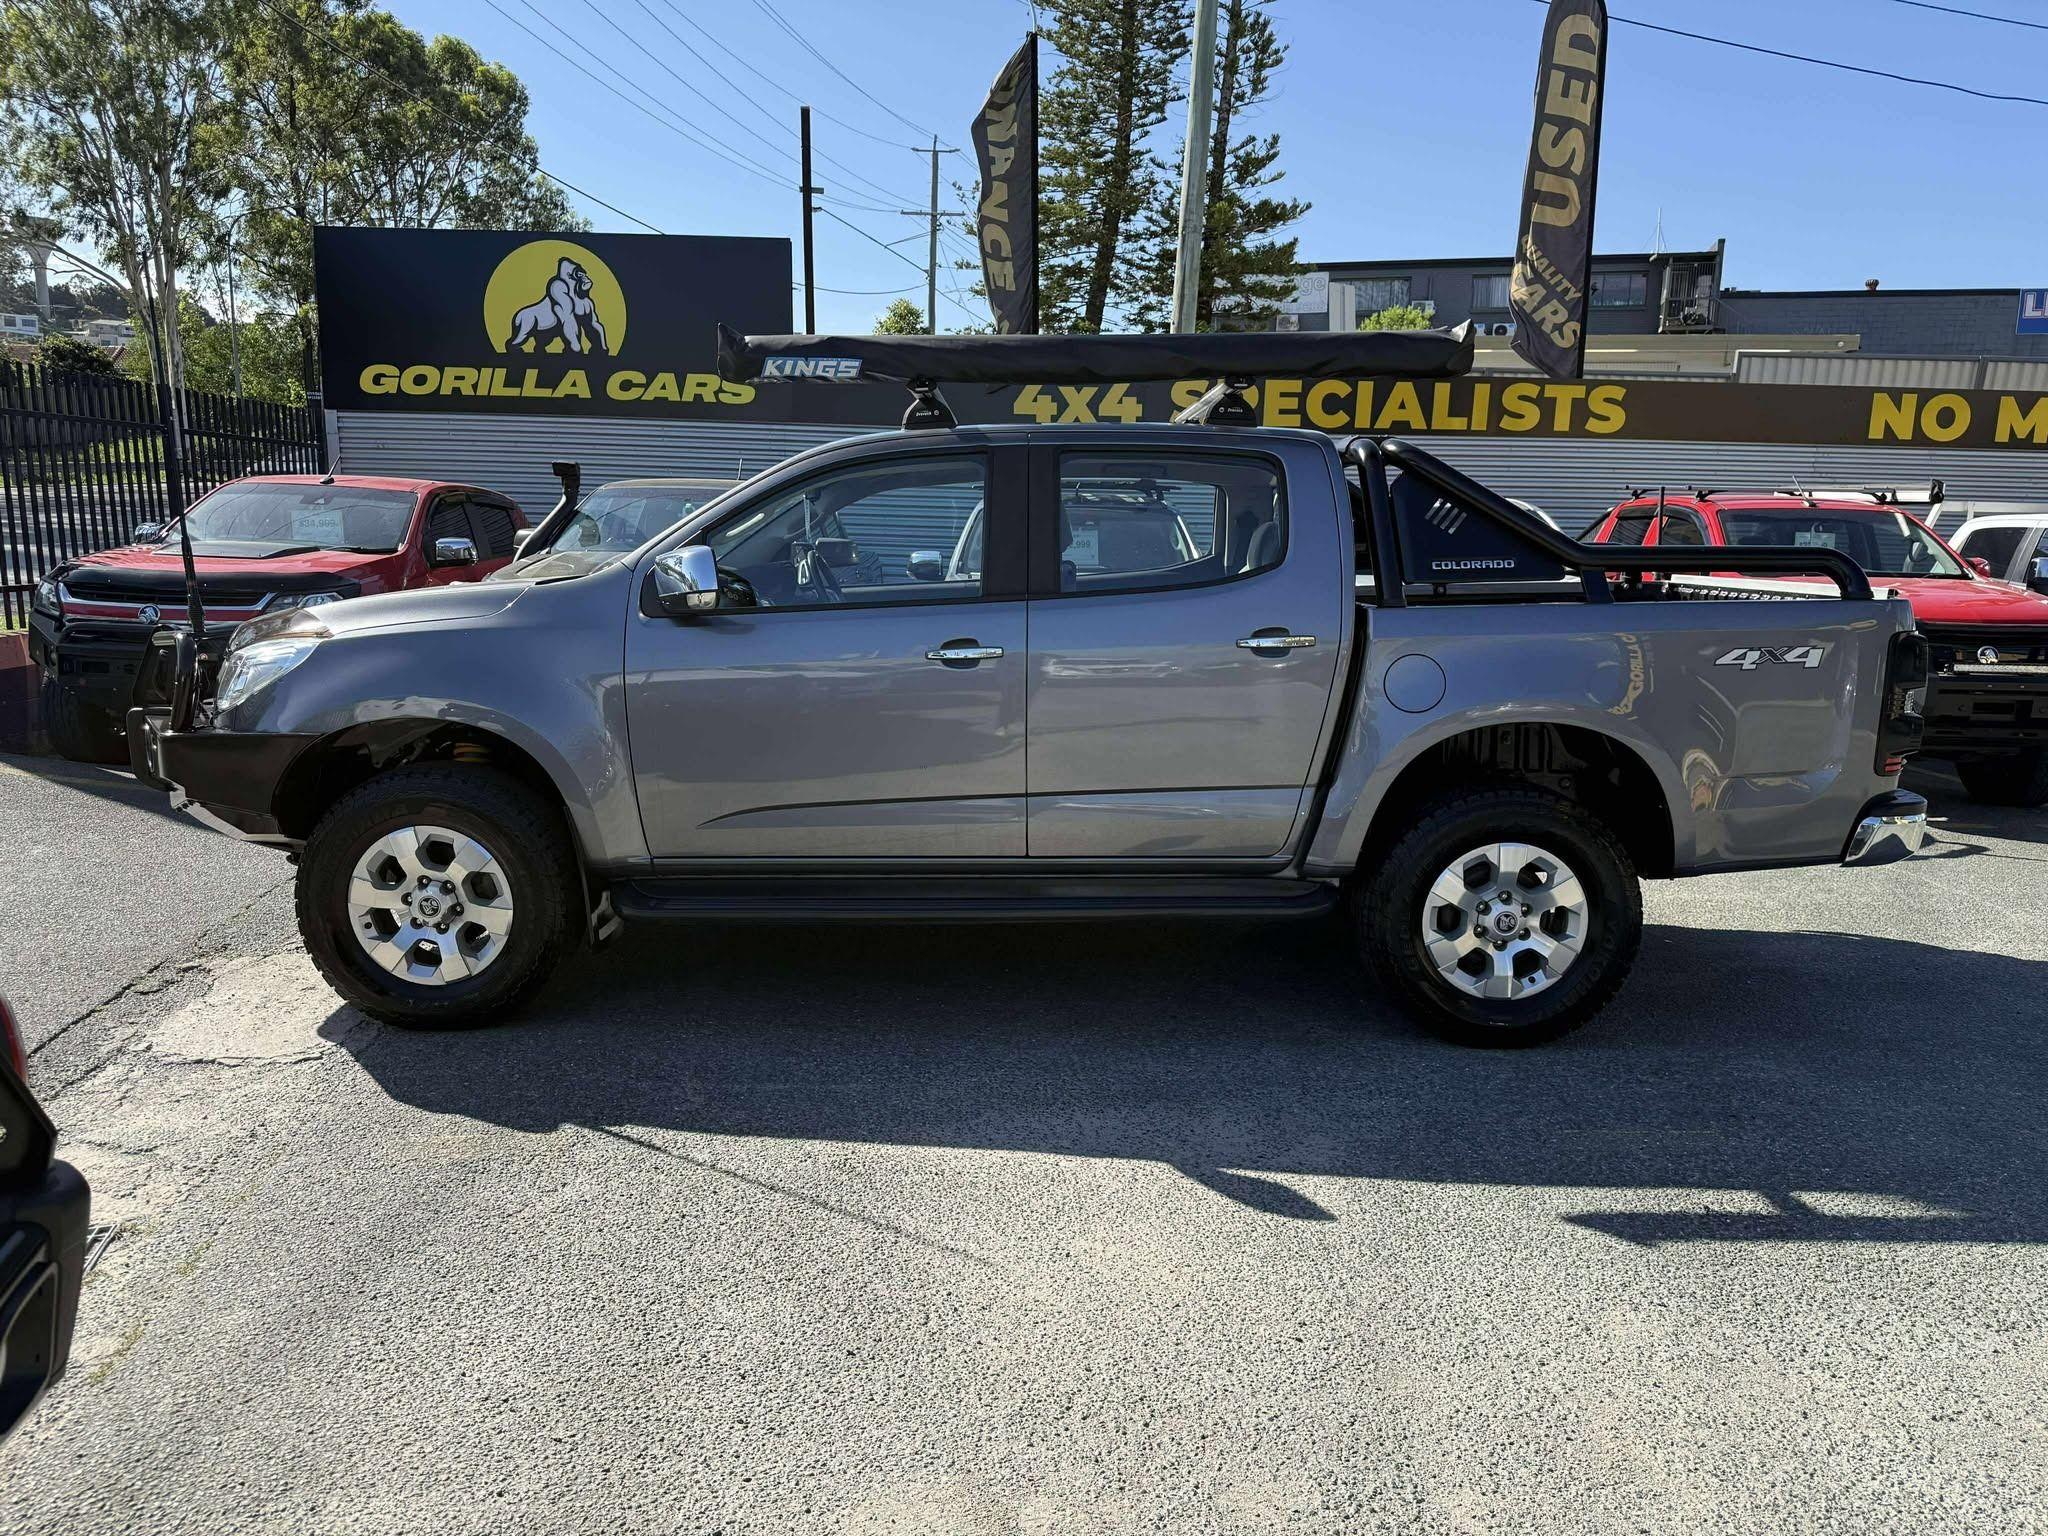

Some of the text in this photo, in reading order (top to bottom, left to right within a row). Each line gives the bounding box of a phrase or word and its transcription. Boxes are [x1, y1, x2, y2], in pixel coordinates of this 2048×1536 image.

[1530, 13, 1600, 228] USED
[359, 364, 756, 404] GORILLA CARS
[763, 359, 860, 377] KINGS
[1868, 392, 1972, 442] NO
[1431, 559, 1515, 570] COLORADO
